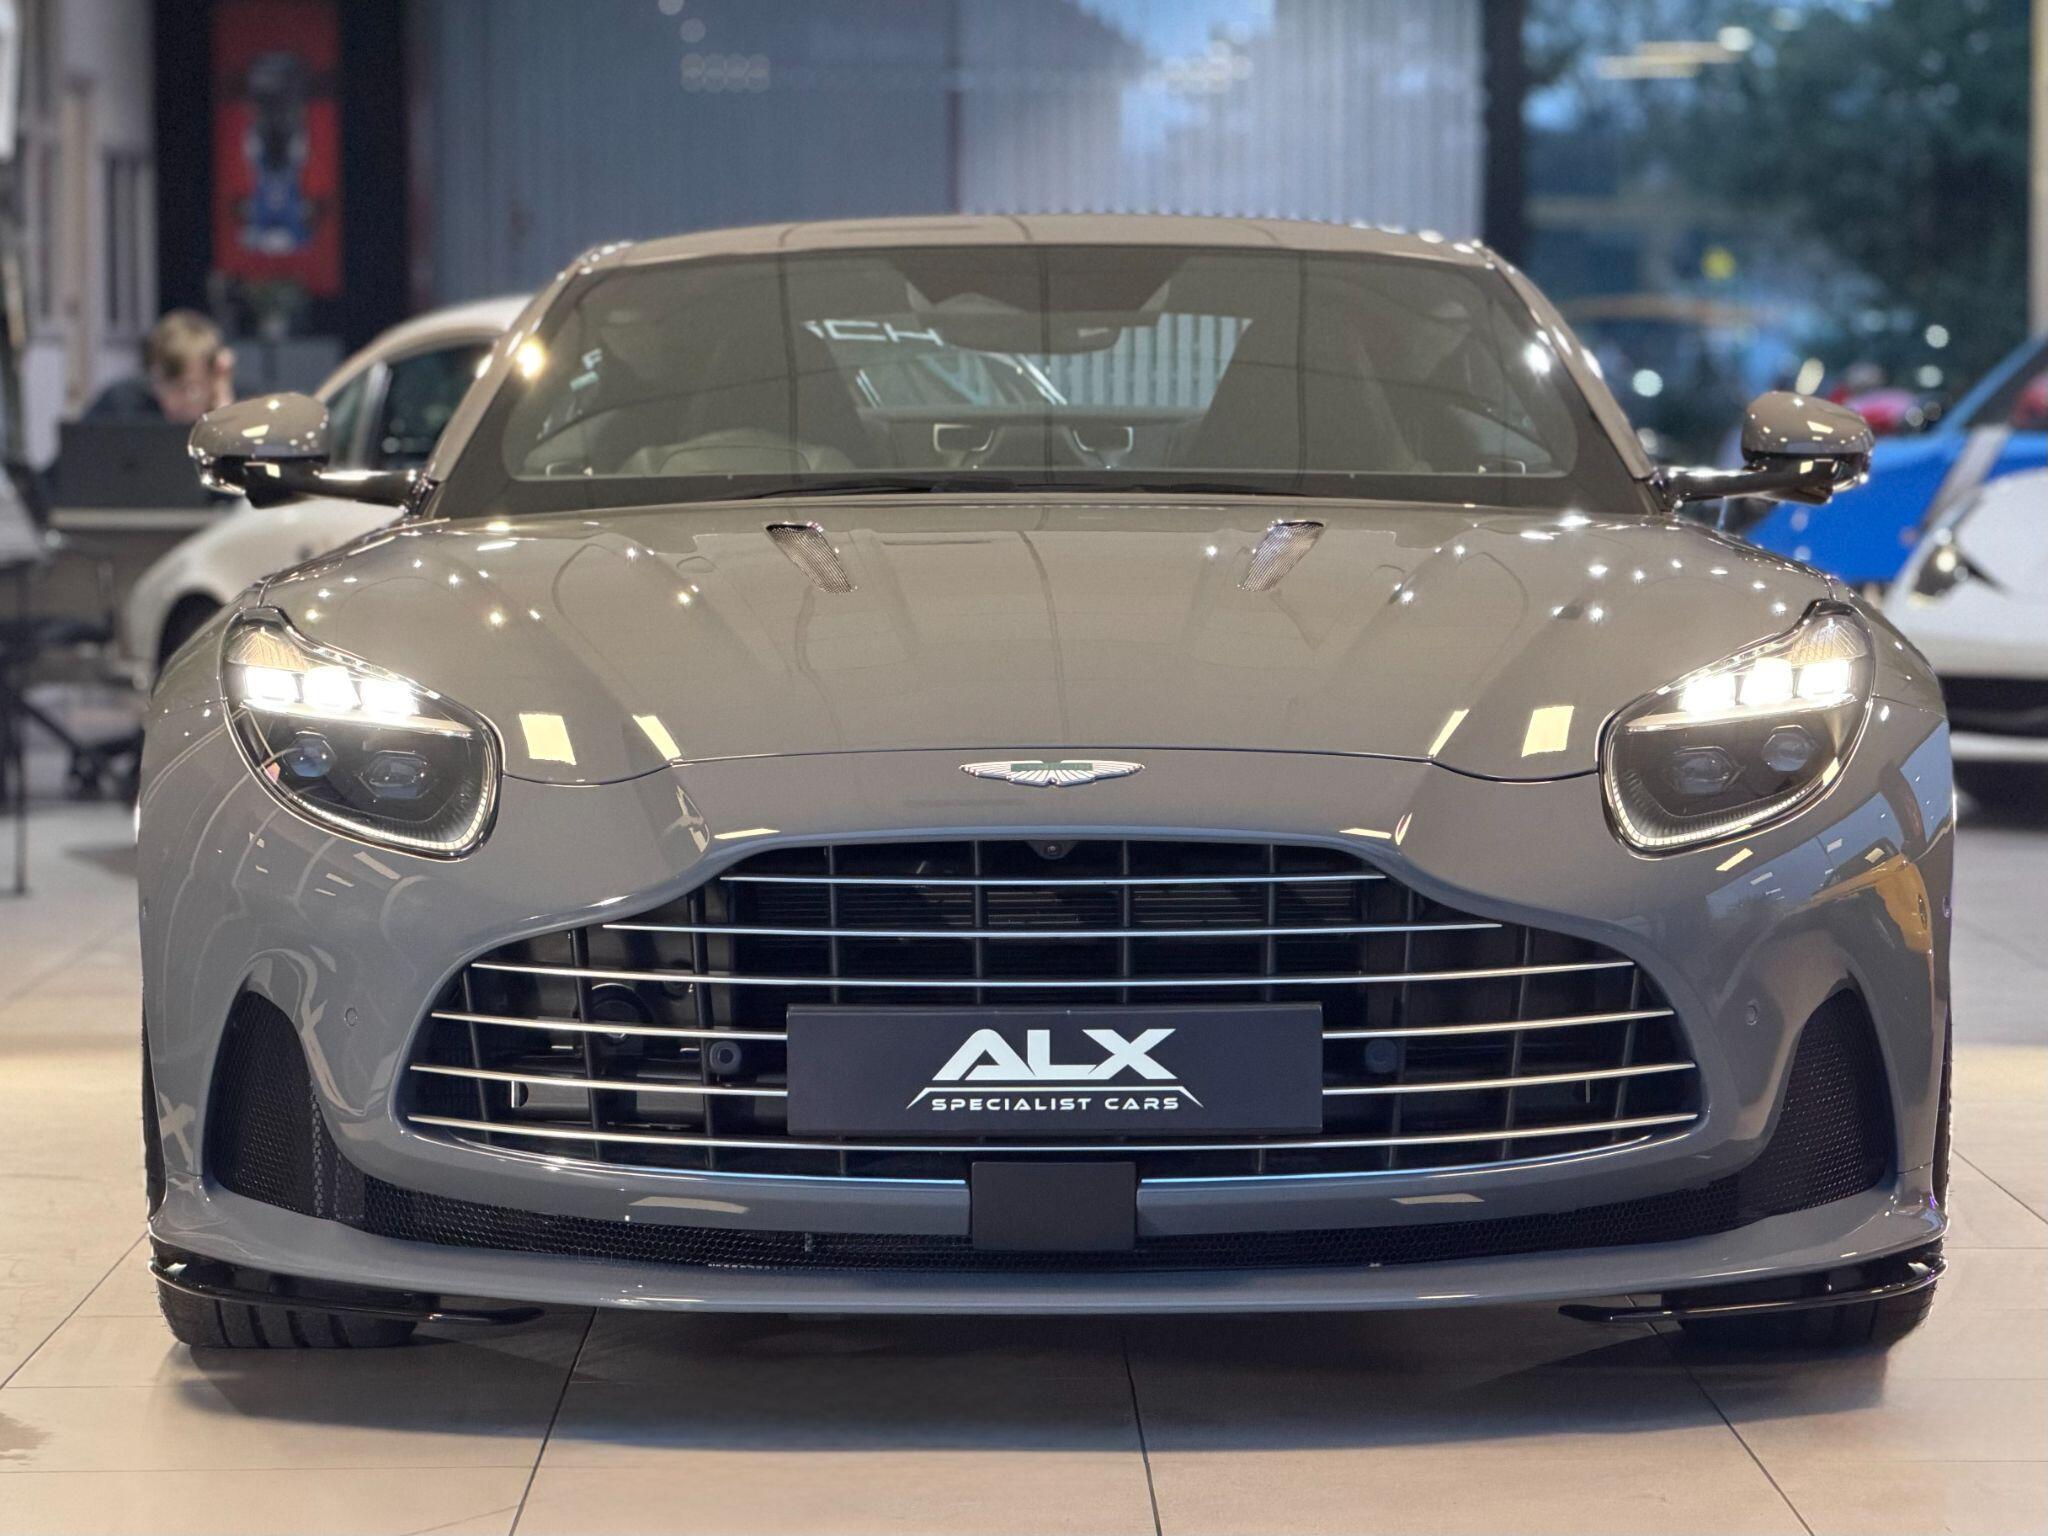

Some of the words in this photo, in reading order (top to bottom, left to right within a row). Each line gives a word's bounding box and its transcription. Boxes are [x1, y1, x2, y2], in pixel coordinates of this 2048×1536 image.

[931, 1028, 1178, 1081] ALX
[931, 1097, 1092, 1111] SPECIALIST
[1104, 1097, 1179, 1111] CARS
